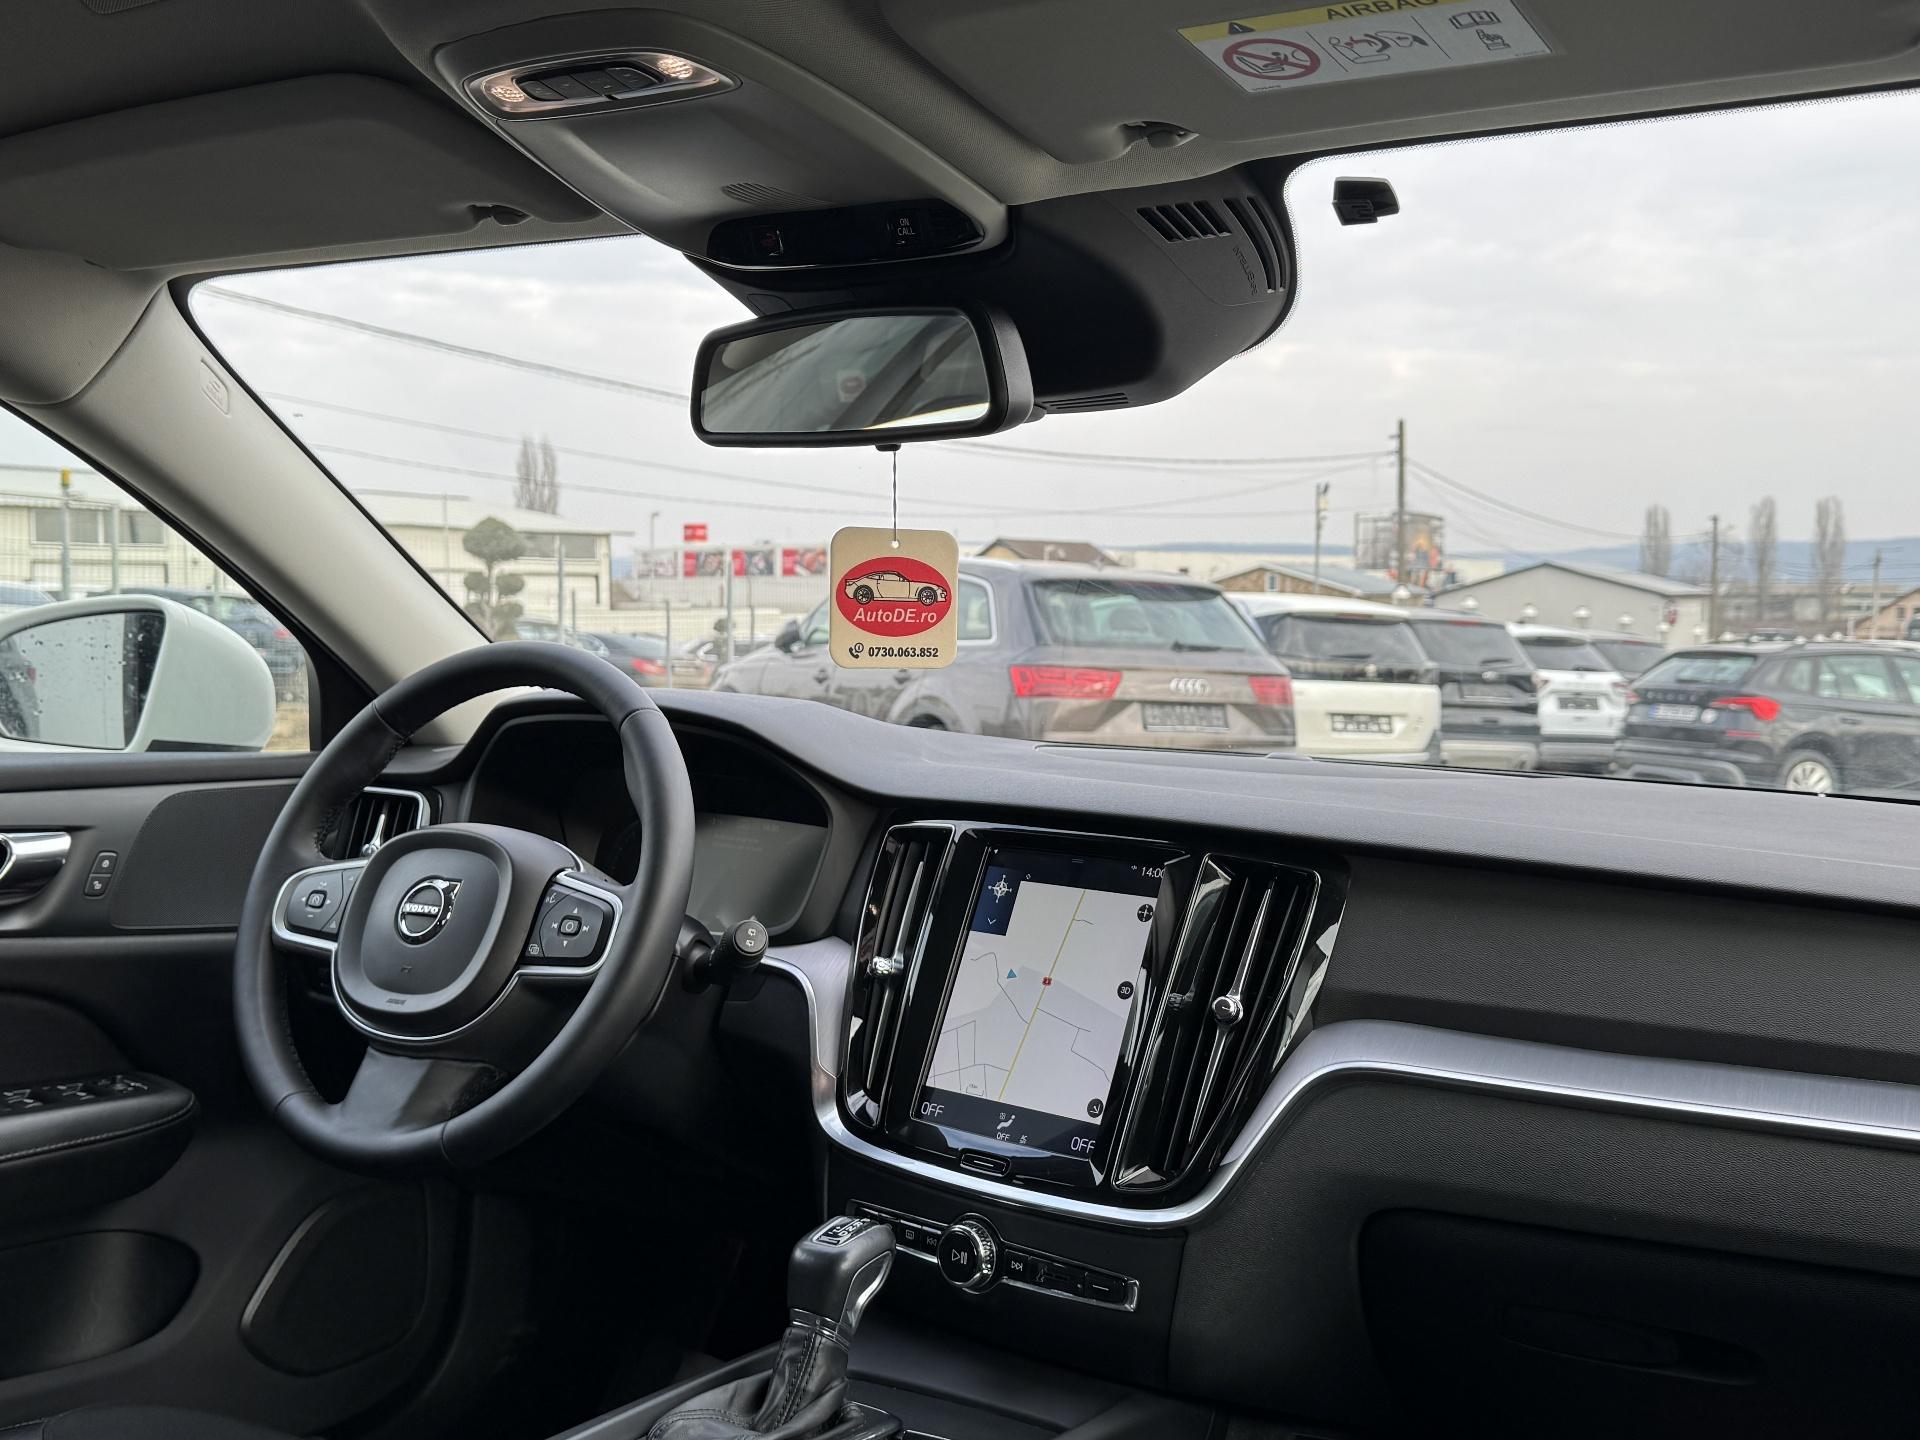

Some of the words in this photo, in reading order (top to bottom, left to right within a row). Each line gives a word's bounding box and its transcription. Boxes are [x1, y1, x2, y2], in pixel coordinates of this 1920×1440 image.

[900, 218, 910, 226] ON
[897, 227, 916, 236] CALL
[853, 607, 937, 623] AutoDE.ro
[868, 646, 939, 658] 0730.063.852
[403, 902, 440, 914] VOLVO
[1120, 986, 1131, 995] 3D
[921, 1101, 945, 1118] OFF
[996, 1131, 1011, 1142] OFF
[1070, 1136, 1097, 1154] OFF
